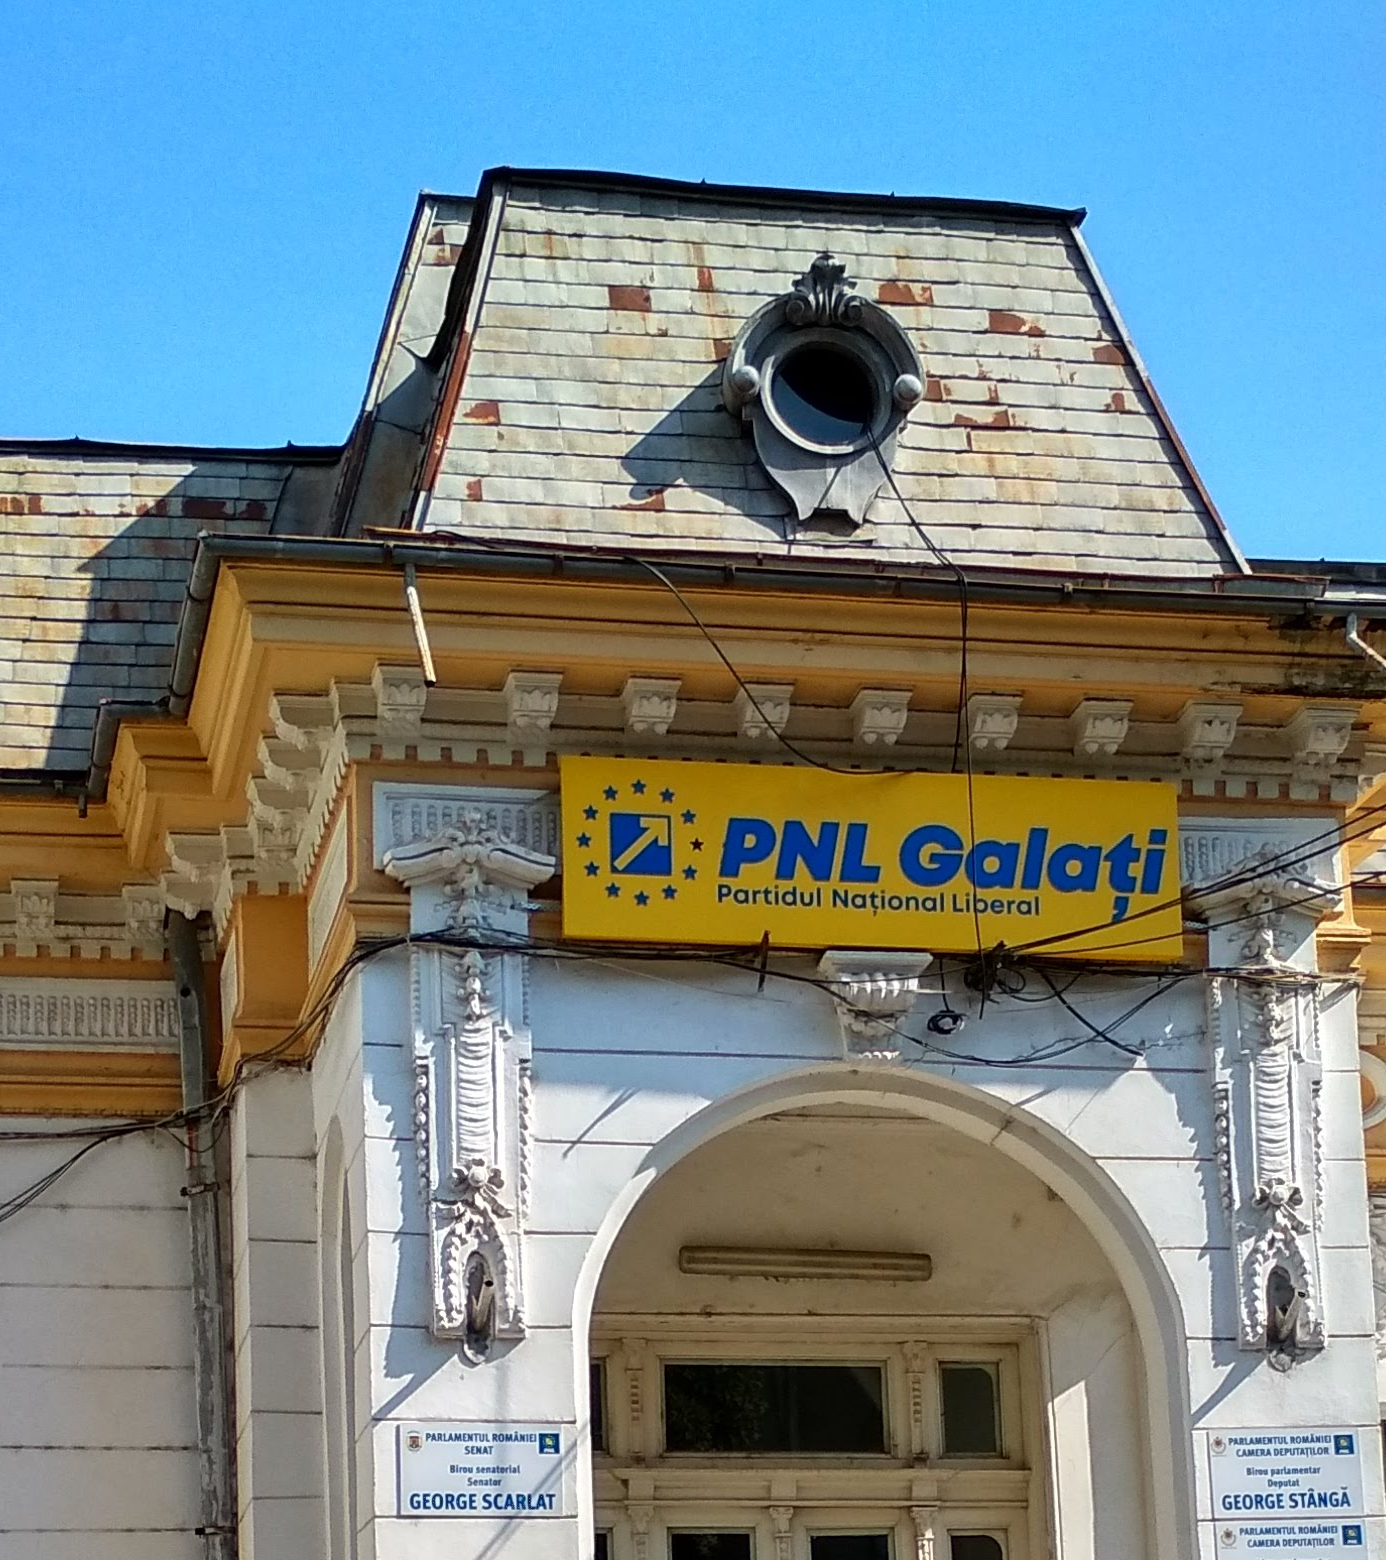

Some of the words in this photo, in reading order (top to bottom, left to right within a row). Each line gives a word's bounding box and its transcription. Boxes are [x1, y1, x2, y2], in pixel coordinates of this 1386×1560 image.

[718, 817, 881, 884] PNL
[899, 823, 1169, 925] Galați
[717, 883, 822, 908] Partidul
[832, 888, 945, 917] Național
[951, 893, 1040, 916] Liberal
[425, 1432, 491, 1443] PARLAMENTUL
[492, 1431, 537, 1443] ROMÂNIEI
[1228, 1435, 1289, 1447] PARLAMENTUL
[1290, 1433, 1332, 1444] ROMÂNIEI
[464, 1446, 494, 1455] SENAT
[1236, 1448, 1272, 1458] CAMERA
[1273, 1447, 1329, 1458] DEPUTAȚILOR
[449, 1464, 474, 1474] Birou
[475, 1464, 521, 1474] senatorial
[1246, 1467, 1269, 1476] Birou
[1270, 1466, 1321, 1477] parlamentar
[467, 1477, 502, 1487] Senator
[1267, 1479, 1300, 1489] Deputat
[409, 1493, 477, 1510] GEORGE
[481, 1493, 556, 1510] SCARLAT
[1222, 1493, 1285, 1511] GEORGE
[1288, 1487, 1351, 1509] STÂNGĂ
[1239, 1525, 1296, 1536] PARLAMENTUL
[1298, 1524, 1338, 1534] ROMÂNIEI
[1247, 1538, 1280, 1548] CAMERA
[1282, 1537, 1335, 1548] DEPUTAȚILOR
